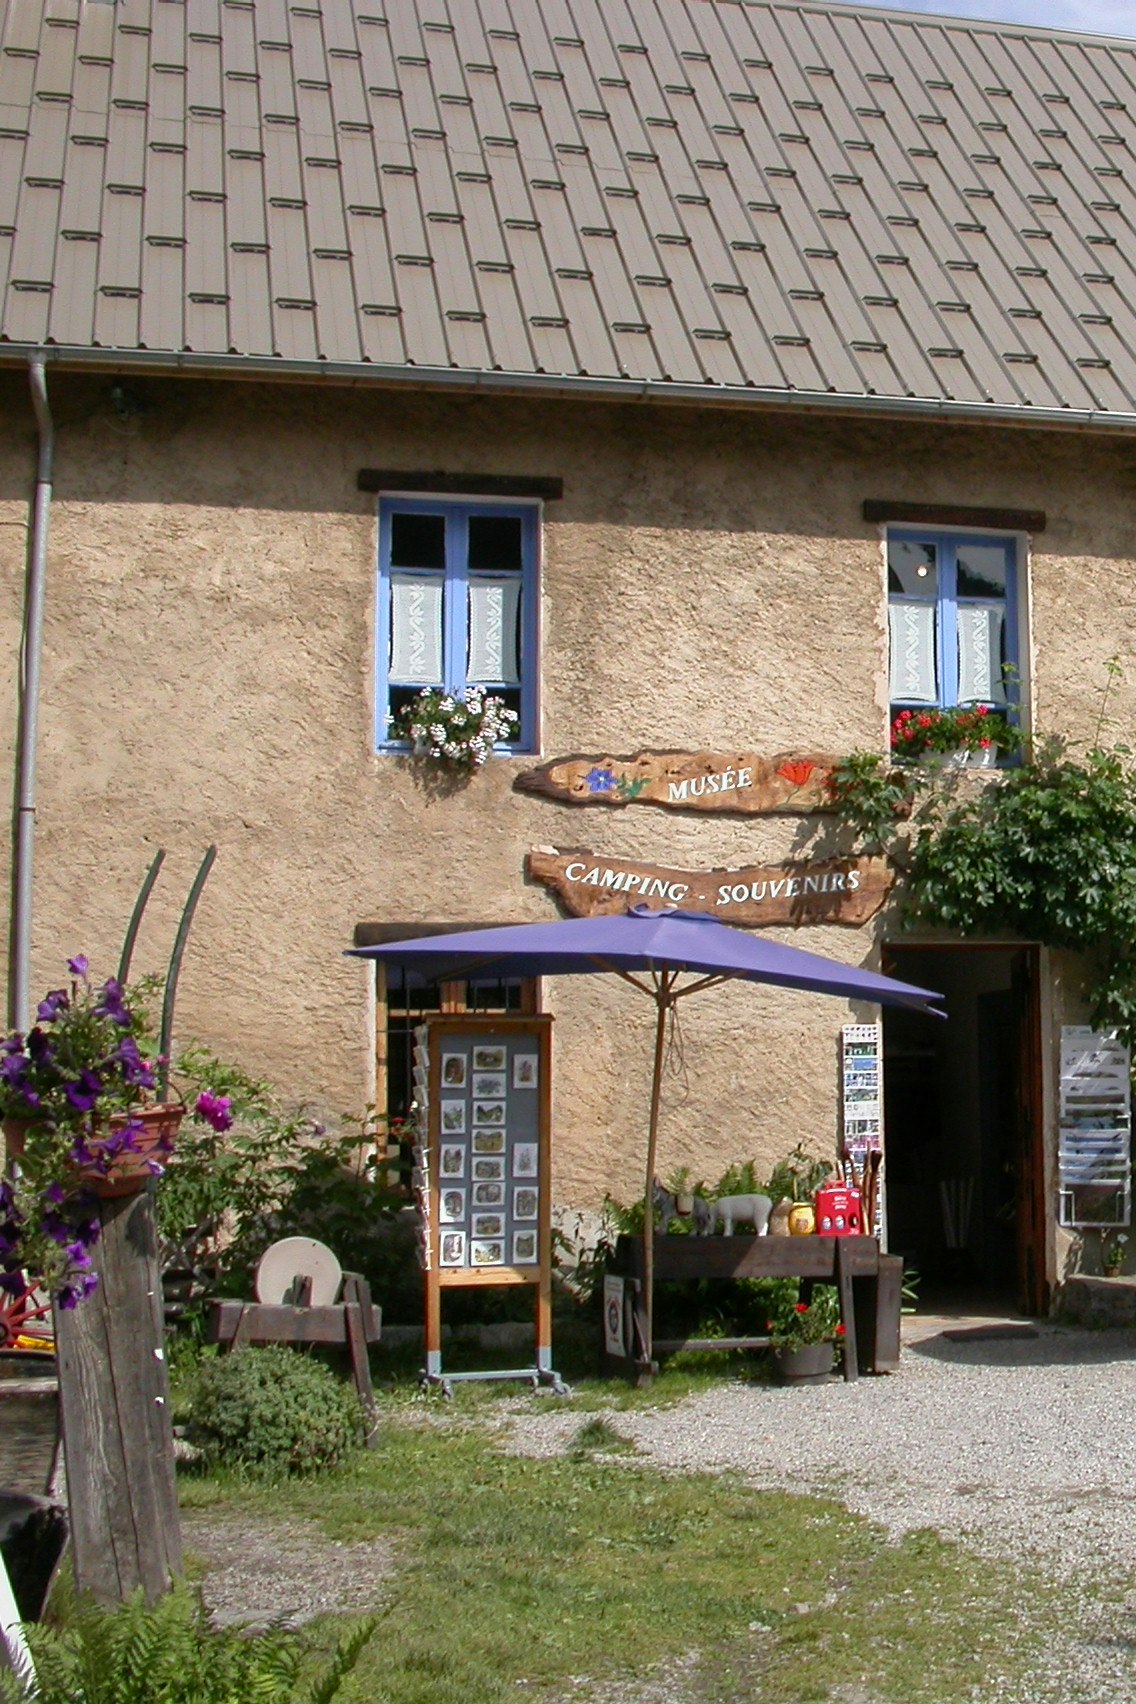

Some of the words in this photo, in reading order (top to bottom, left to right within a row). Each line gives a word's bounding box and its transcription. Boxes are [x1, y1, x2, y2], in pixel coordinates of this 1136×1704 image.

[667, 766, 753, 802] MUSÉE
[564, 862, 688, 902] CAMPING
[716, 870, 861, 906] SOUVENIRS
